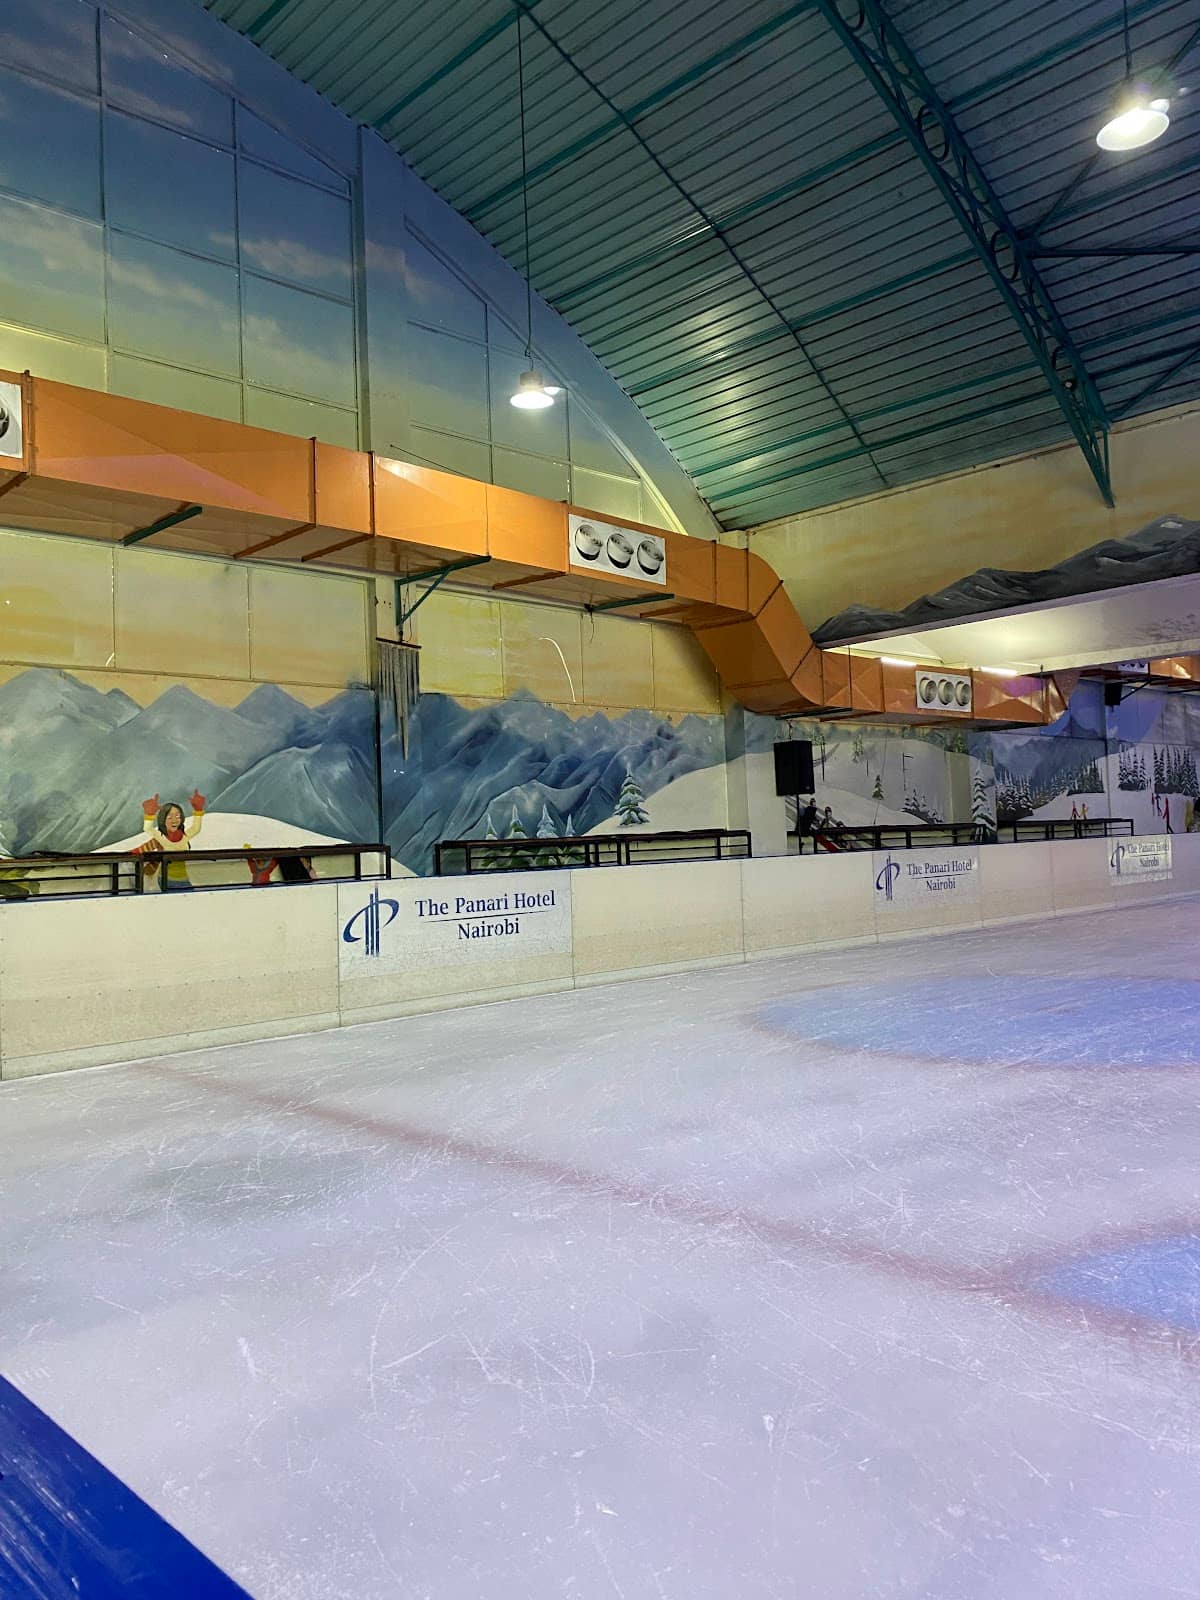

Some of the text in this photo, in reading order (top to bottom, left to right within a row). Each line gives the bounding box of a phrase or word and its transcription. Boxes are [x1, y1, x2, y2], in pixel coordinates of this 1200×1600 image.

[906, 858, 972, 876] The Panari Hotel
[926, 878, 956, 891] Nairobi
[415, 890, 556, 917] The Panari Hotel
[458, 917, 520, 940] Nairobi
